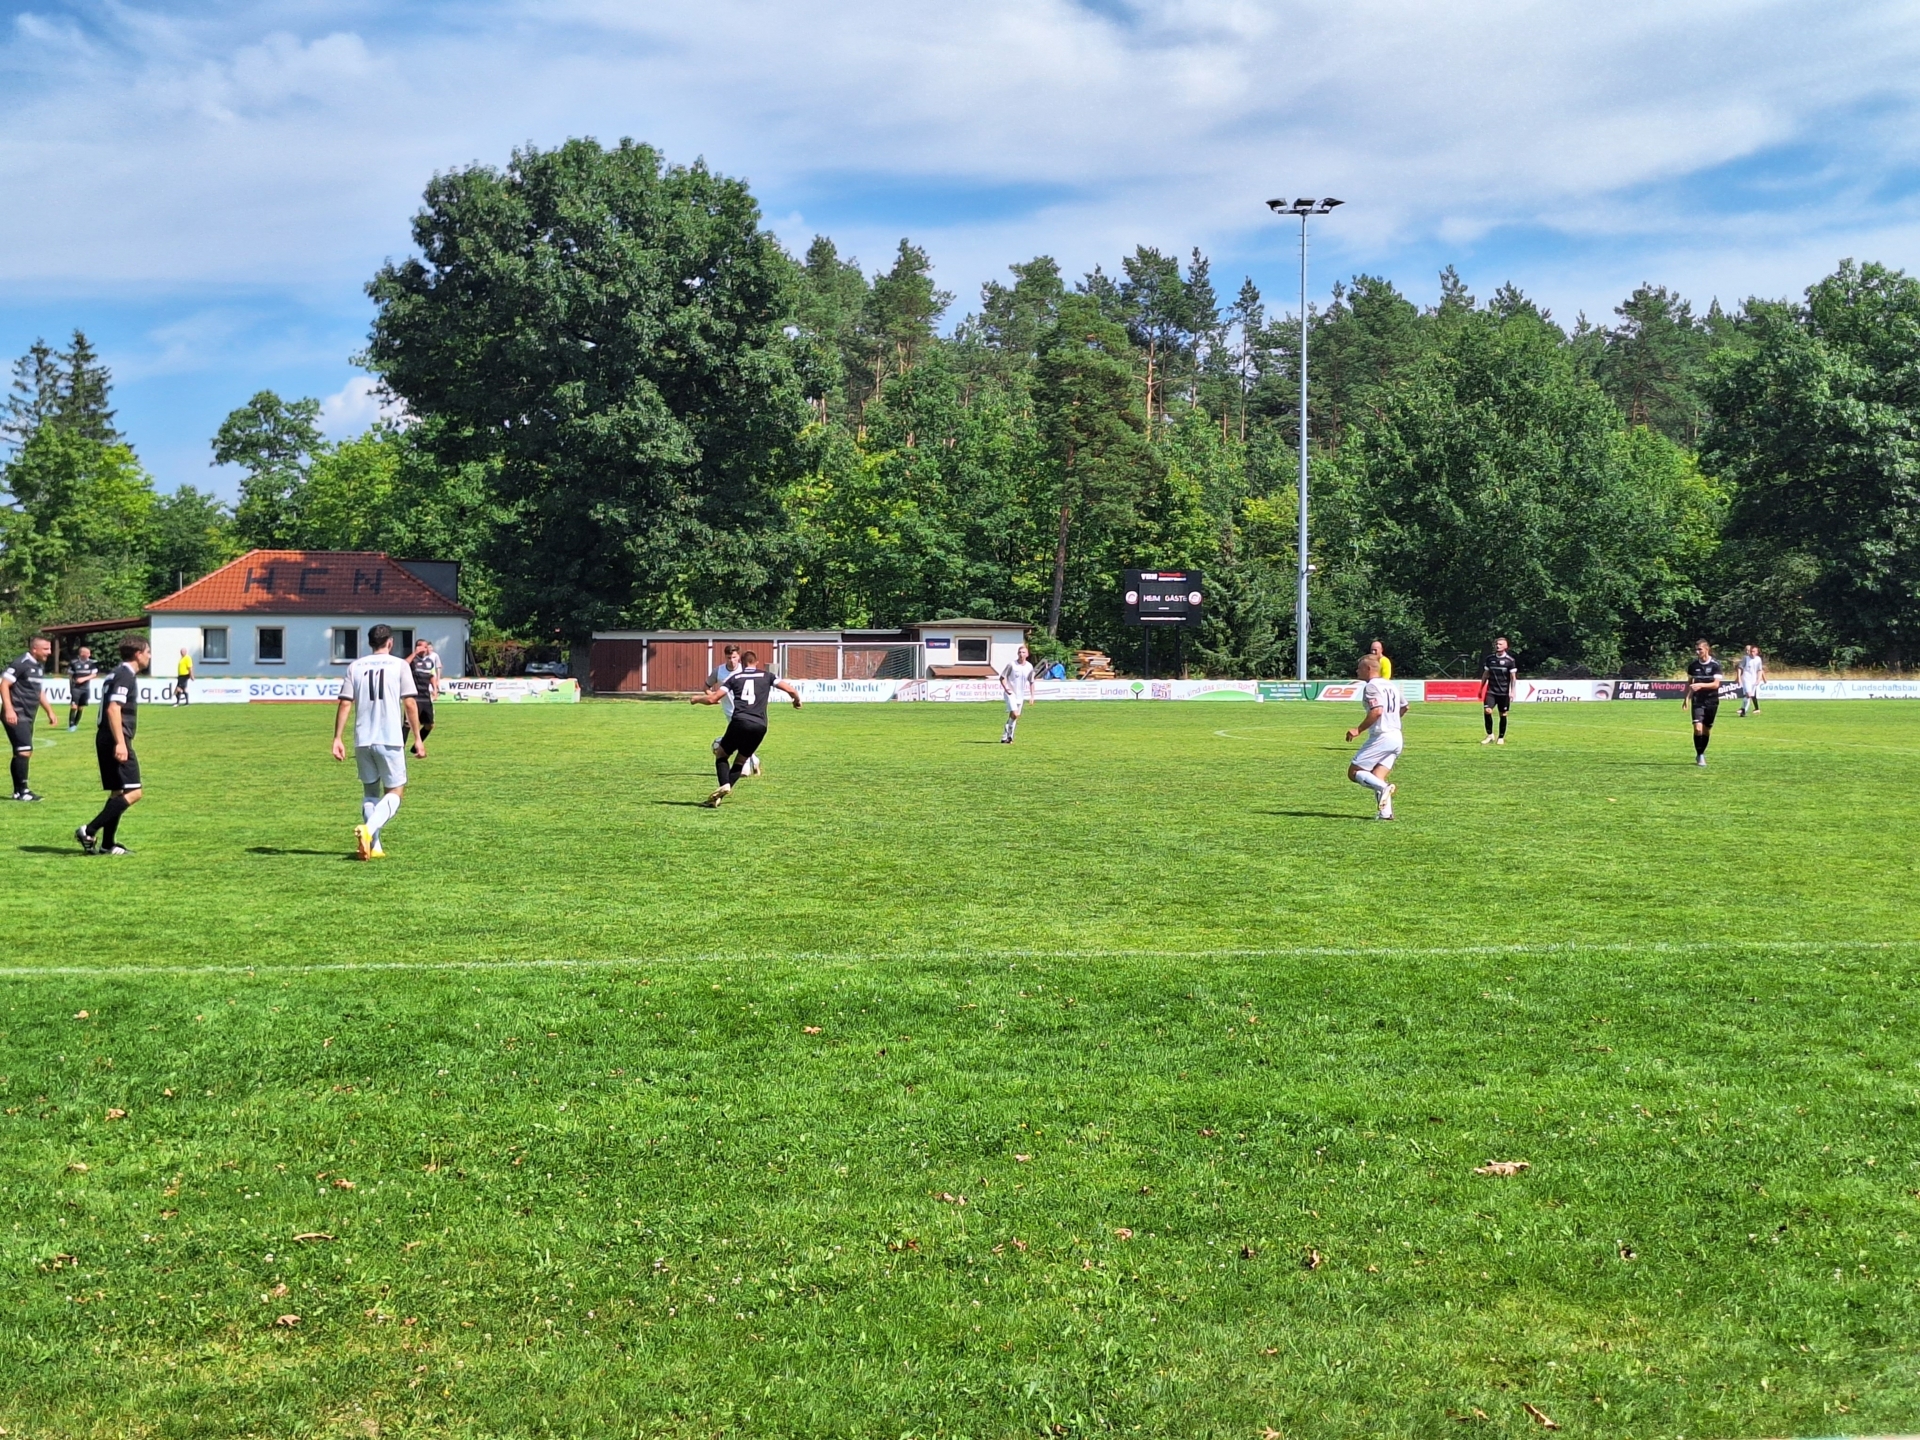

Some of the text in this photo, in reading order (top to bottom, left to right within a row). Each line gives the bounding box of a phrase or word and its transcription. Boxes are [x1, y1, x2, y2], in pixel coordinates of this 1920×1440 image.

[249, 684, 309, 696] SPORT
[364, 668, 384, 701] 11
[448, 682, 494, 690] WEINERT
[1619, 681, 1686, 692] Für Ihre Werbung
[741, 679, 756, 705] 4
[1537, 687, 1564, 695] raab
[1619, 691, 1634, 699] das
[1382, 688, 1396, 713] 13
